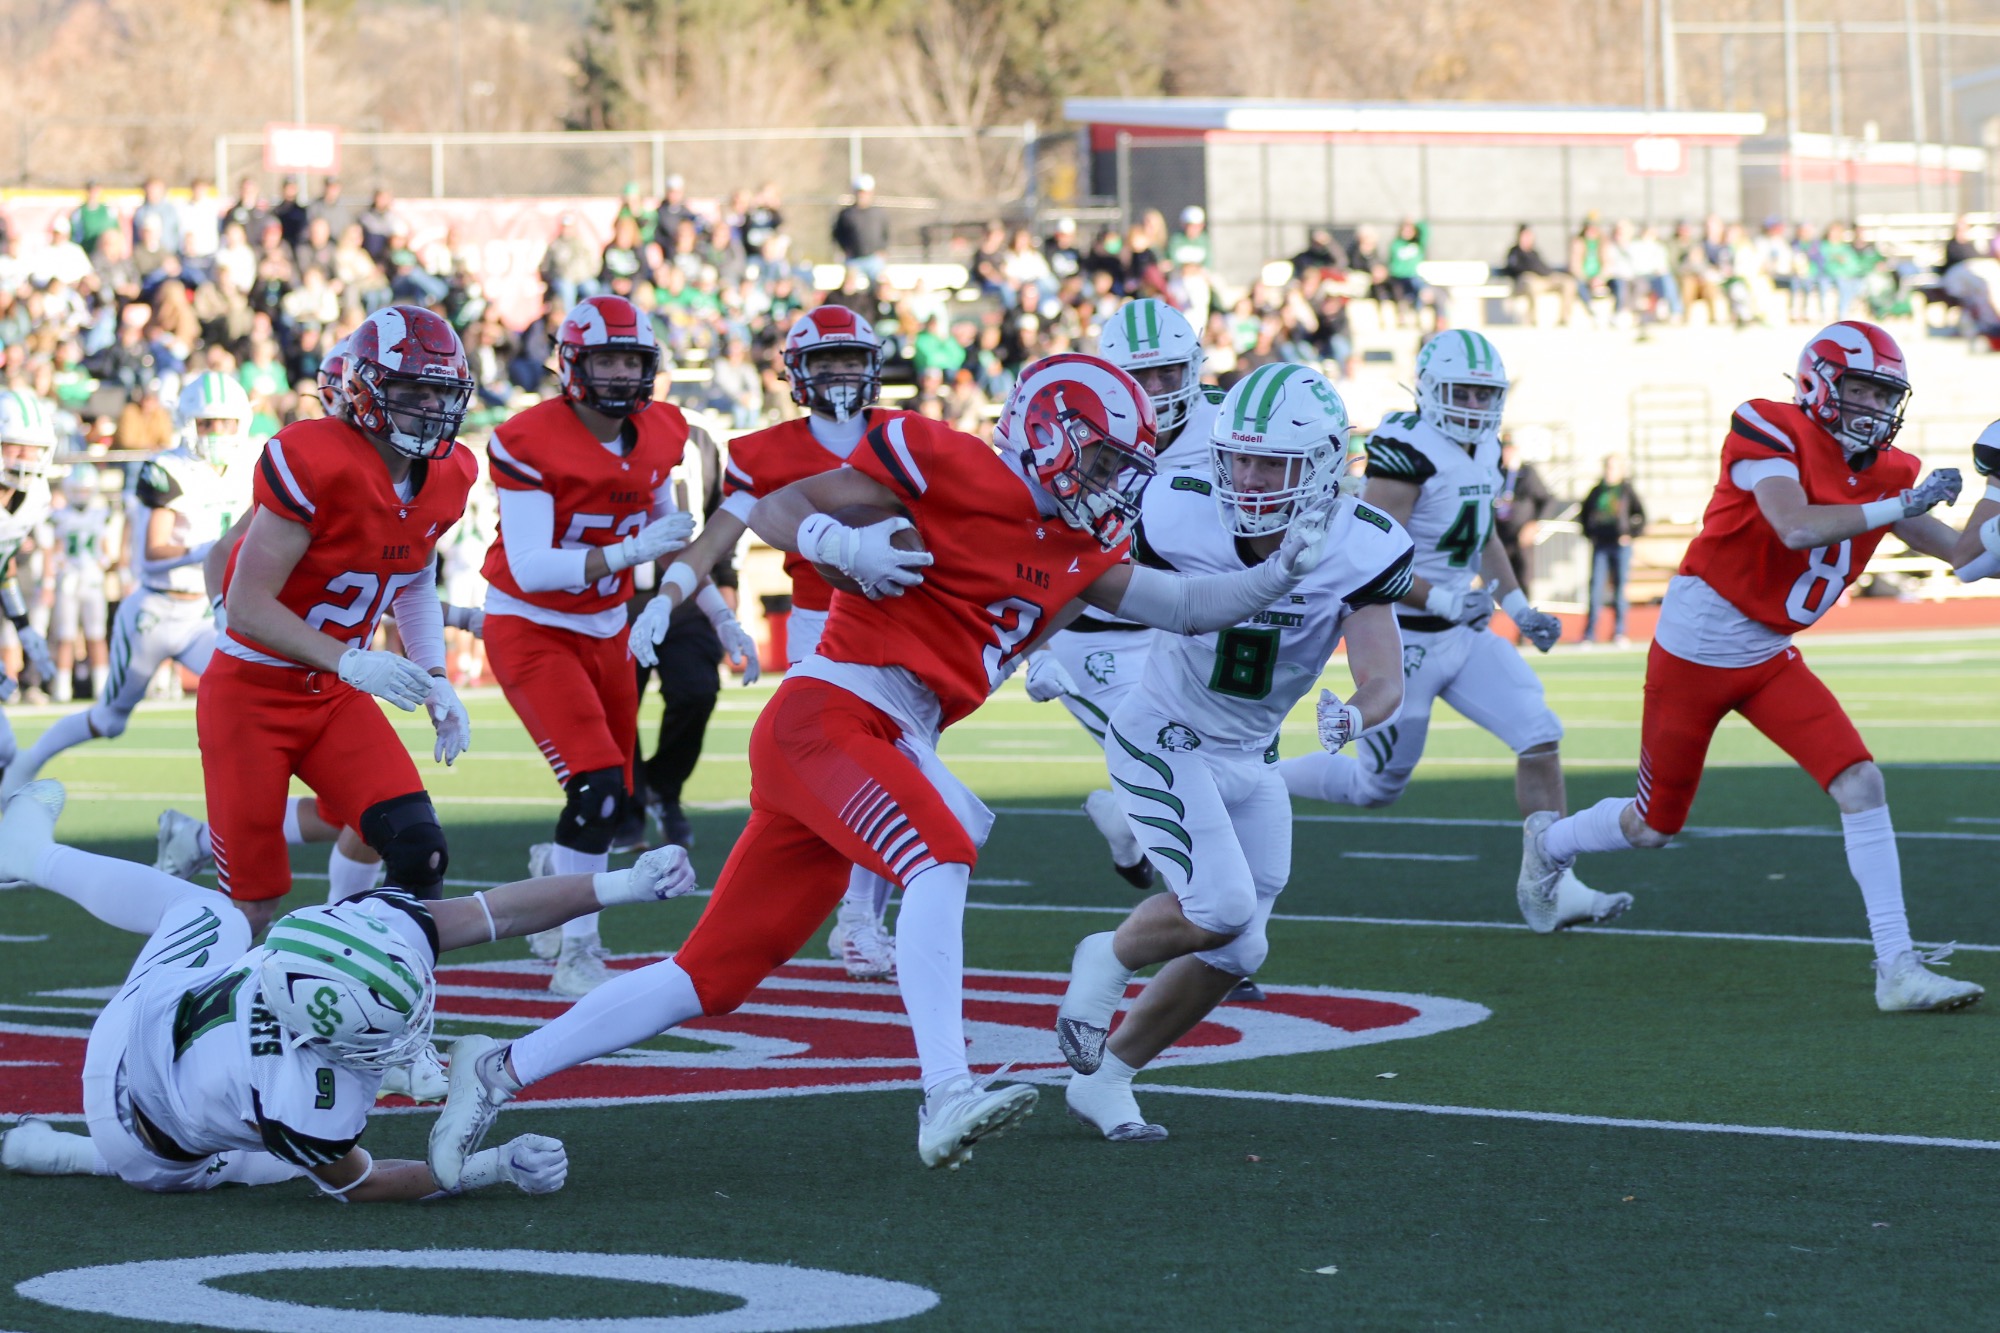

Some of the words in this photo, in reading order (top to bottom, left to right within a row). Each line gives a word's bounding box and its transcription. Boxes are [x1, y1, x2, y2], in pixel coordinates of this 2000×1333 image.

[1132, 351, 1160, 360] Riddell
[1231, 431, 1263, 444] Riddell
[381, 545, 410, 560] RAMS
[1016, 562, 1051, 590] RAMS
[1784, 538, 1853, 626] 8
[1207, 627, 1281, 701] 8
[314, 1067, 336, 1110] 9
